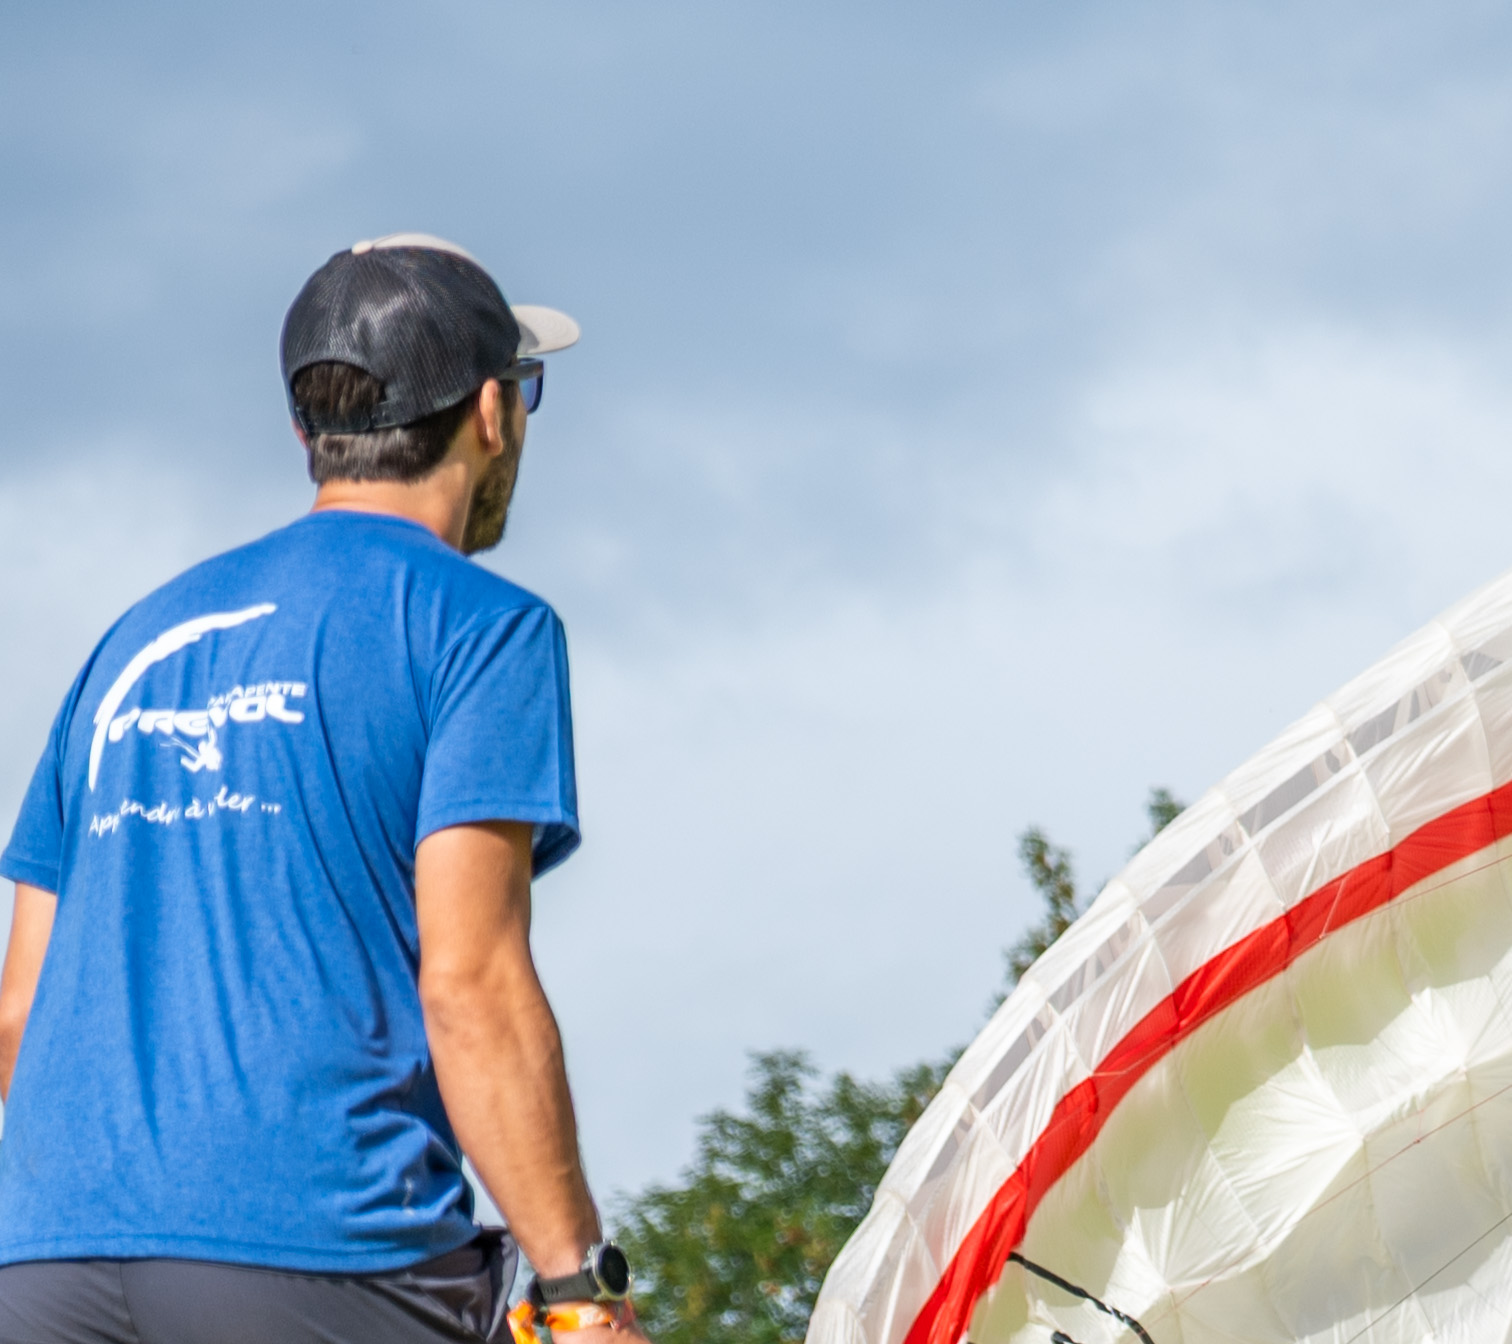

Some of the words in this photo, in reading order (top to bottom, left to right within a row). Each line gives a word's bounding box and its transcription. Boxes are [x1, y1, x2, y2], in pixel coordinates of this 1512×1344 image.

[108, 694, 304, 743] PREVOL
[88, 798, 180, 838] Appendr
[208, 784, 256, 816] vler
